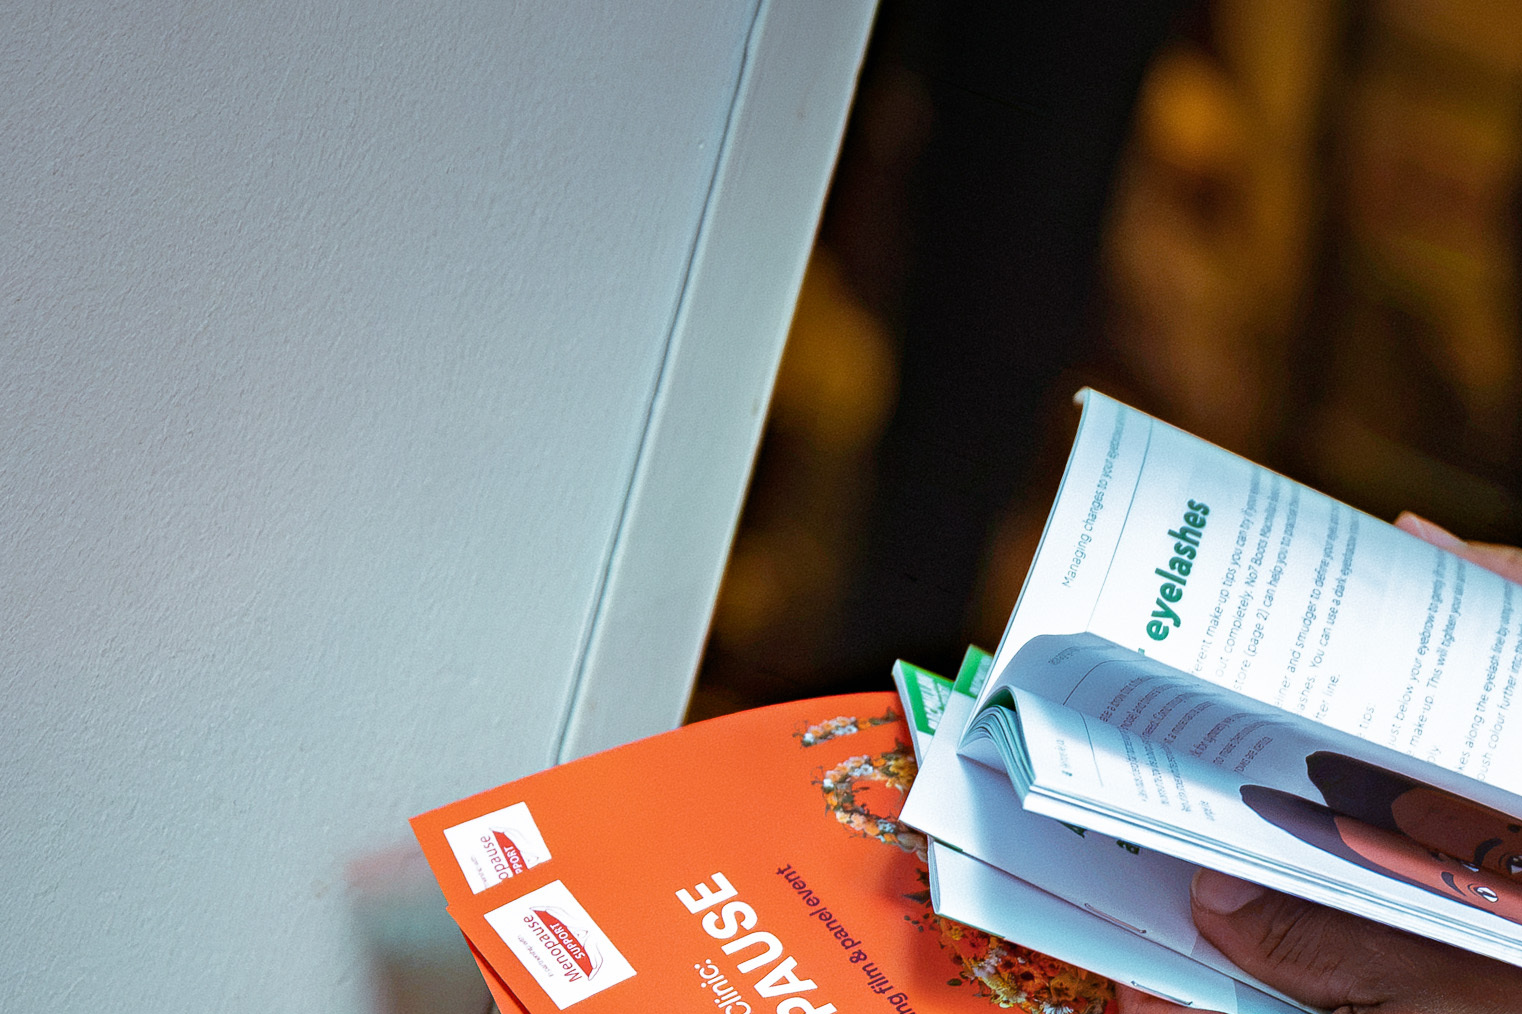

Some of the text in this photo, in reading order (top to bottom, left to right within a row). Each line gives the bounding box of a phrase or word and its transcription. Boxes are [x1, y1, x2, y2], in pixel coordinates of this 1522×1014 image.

[1061, 532, 1093, 588] Managing
[1082, 489, 1105, 532] changes
[1145, 498, 1211, 642] eyelashes
[1205, 588, 1231, 638] make-up
[1221, 567, 1237, 588] tips
[1223, 590, 1255, 654] completely.
[1244, 564, 1259, 588] No7
[1255, 608, 1271, 622] 2)
[1262, 588, 1276, 609] can
[1247, 622, 1265, 657] (page
[1286, 649, 1302, 674] and
[1295, 599, 1317, 649] smudger
[1308, 648, 1326, 668] You
[1319, 626, 1332, 647] can
[1326, 606, 1339, 626] use
[1233, 659, 1252, 691] store
[1326, 672, 1341, 698] line.
[1394, 684, 1415, 721] below
[1409, 656, 1423, 684] your
[1425, 667, 1444, 689] This
[1496, 674, 1517, 711] further
[1464, 713, 1486, 749] along
[1475, 693, 1490, 713] the
[1487, 711, 1506, 750] colour
[775, 863, 821, 907] event
[523, 914, 583, 983] Menopause
[549, 922, 586, 960] SUPPORT
[808, 906, 862, 951] panel
[848, 949, 868, 964] &
[861, 962, 894, 995] film
